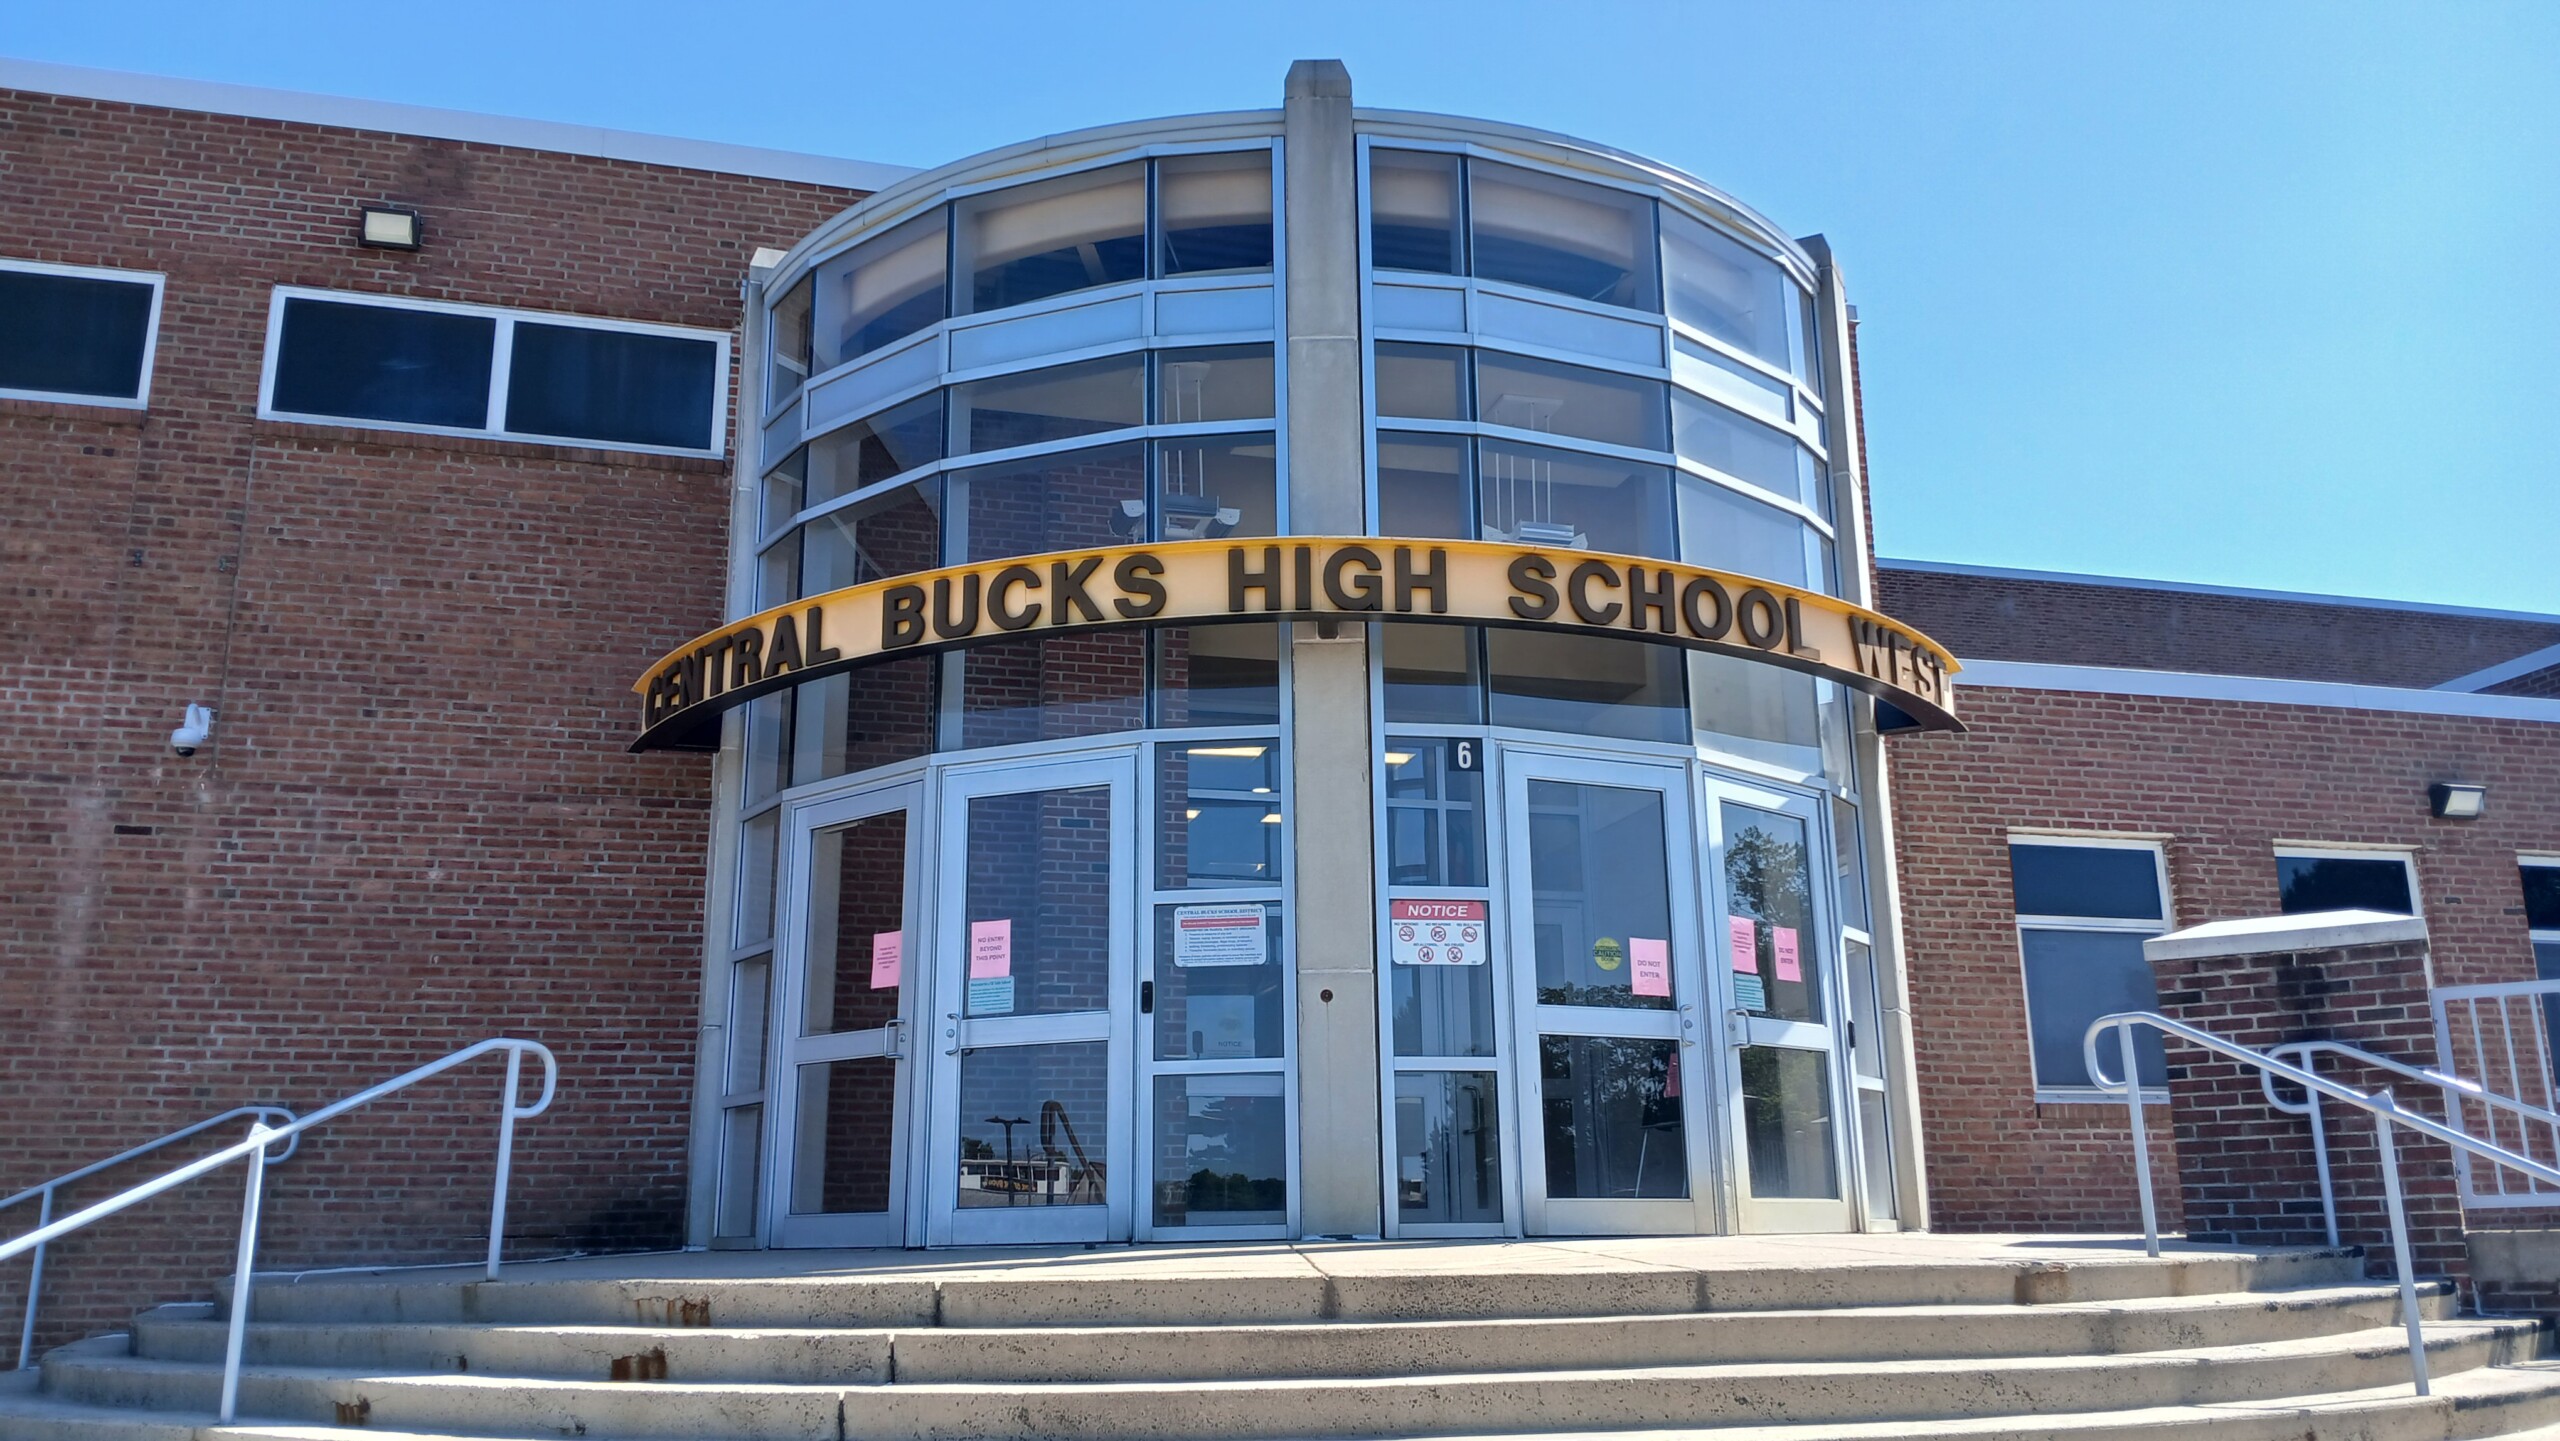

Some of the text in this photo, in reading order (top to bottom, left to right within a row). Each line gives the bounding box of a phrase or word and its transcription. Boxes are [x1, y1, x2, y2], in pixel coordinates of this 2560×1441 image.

[645, 546, 1948, 731] CENTRAL BUCKS HIGH SCHOOL WEST
[1457, 741, 1472, 769] 6
[1407, 904, 1469, 917] NOTICE
